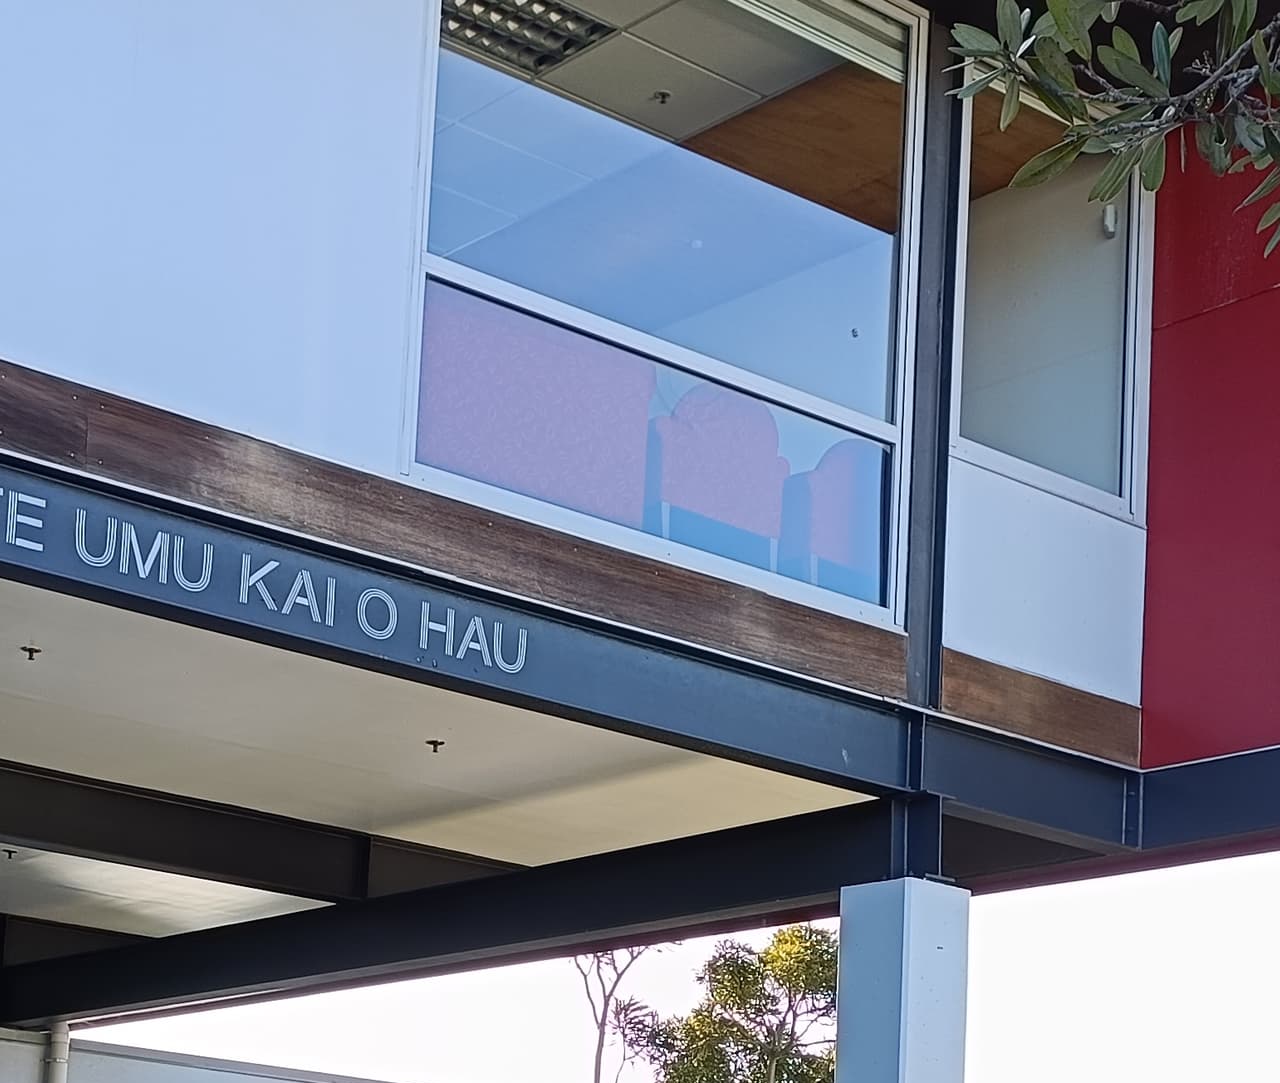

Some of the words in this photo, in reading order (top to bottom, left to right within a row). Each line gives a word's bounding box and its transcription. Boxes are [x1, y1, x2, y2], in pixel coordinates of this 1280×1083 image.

[74, 507, 213, 592] UMU
[239, 552, 337, 627] KAI
[356, 588, 398, 640] O
[419, 601, 528, 673] HAU
